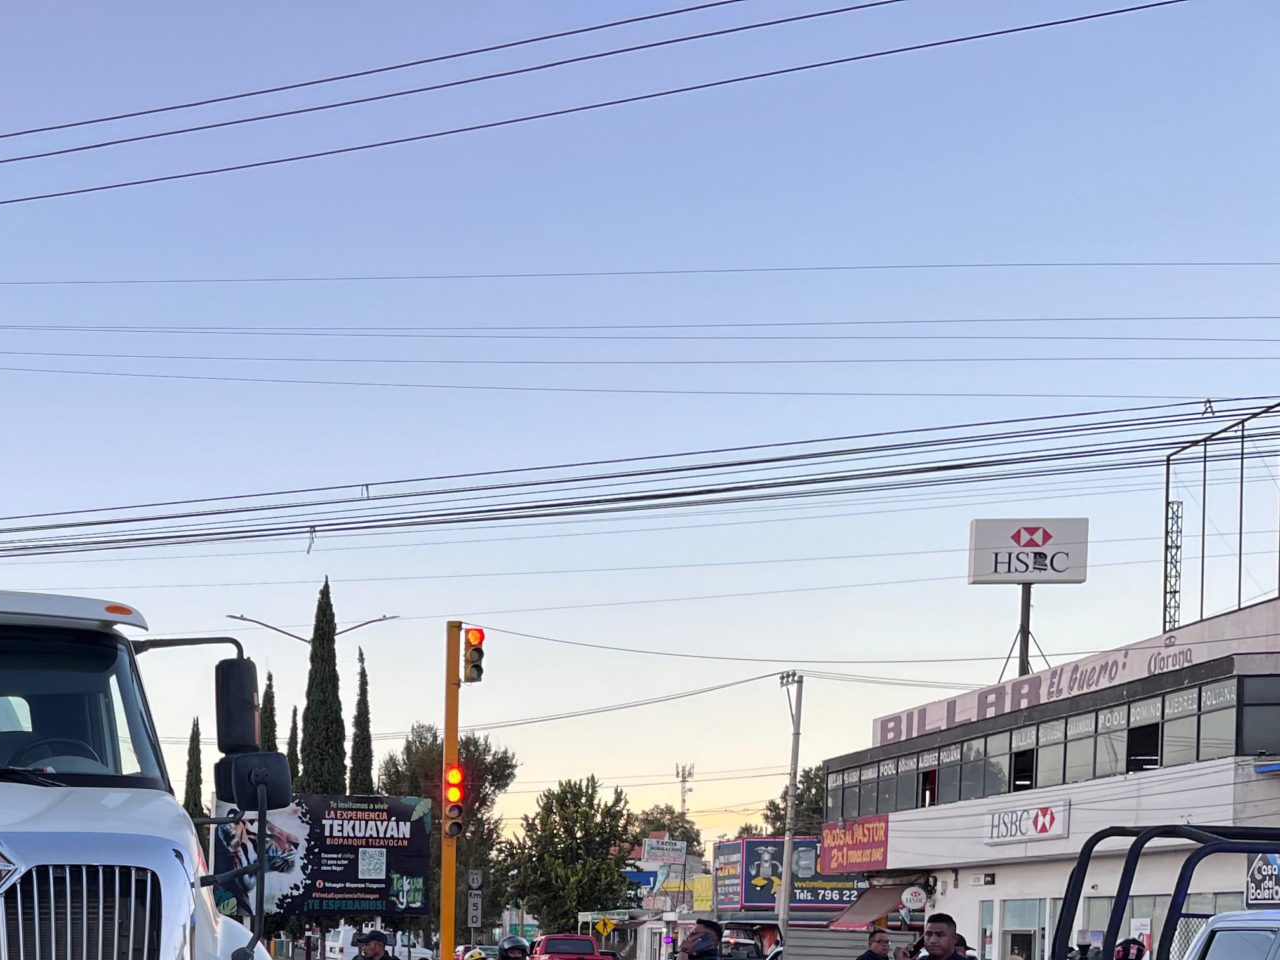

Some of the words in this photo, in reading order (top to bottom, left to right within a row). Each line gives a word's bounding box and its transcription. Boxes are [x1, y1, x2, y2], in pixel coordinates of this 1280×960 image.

[992, 551, 1069, 573] HSBC
[1148, 648, 1193, 675] Corona
[880, 676, 1042, 746] BILLAR
[1100, 711, 1125, 728] POOL
[1130, 703, 1160, 722] DOMINO
[1165, 694, 1197, 714] AJEDREZ
[880, 765, 896, 776] POOL
[325, 810, 335, 819] LA
[337, 811, 388, 820] EXPERIENCIA
[338, 801, 368, 809] invitamos
[322, 817, 410, 838] TEKUAYÁN
[823, 828, 845, 847] TACOS
[845, 830, 852, 845] AL
[853, 822, 885, 844] PASTOR
[990, 810, 1029, 839] HSBC
[326, 838, 366, 846] BIOPARQUE
[369, 839, 408, 847] TIZAYOCAN
[1254, 860, 1278, 880] Casa
[1264, 876, 1275, 888] del
[794, 890, 814, 900] Tels.
[818, 890, 840, 900] 796
[843, 890, 858, 901] 22
